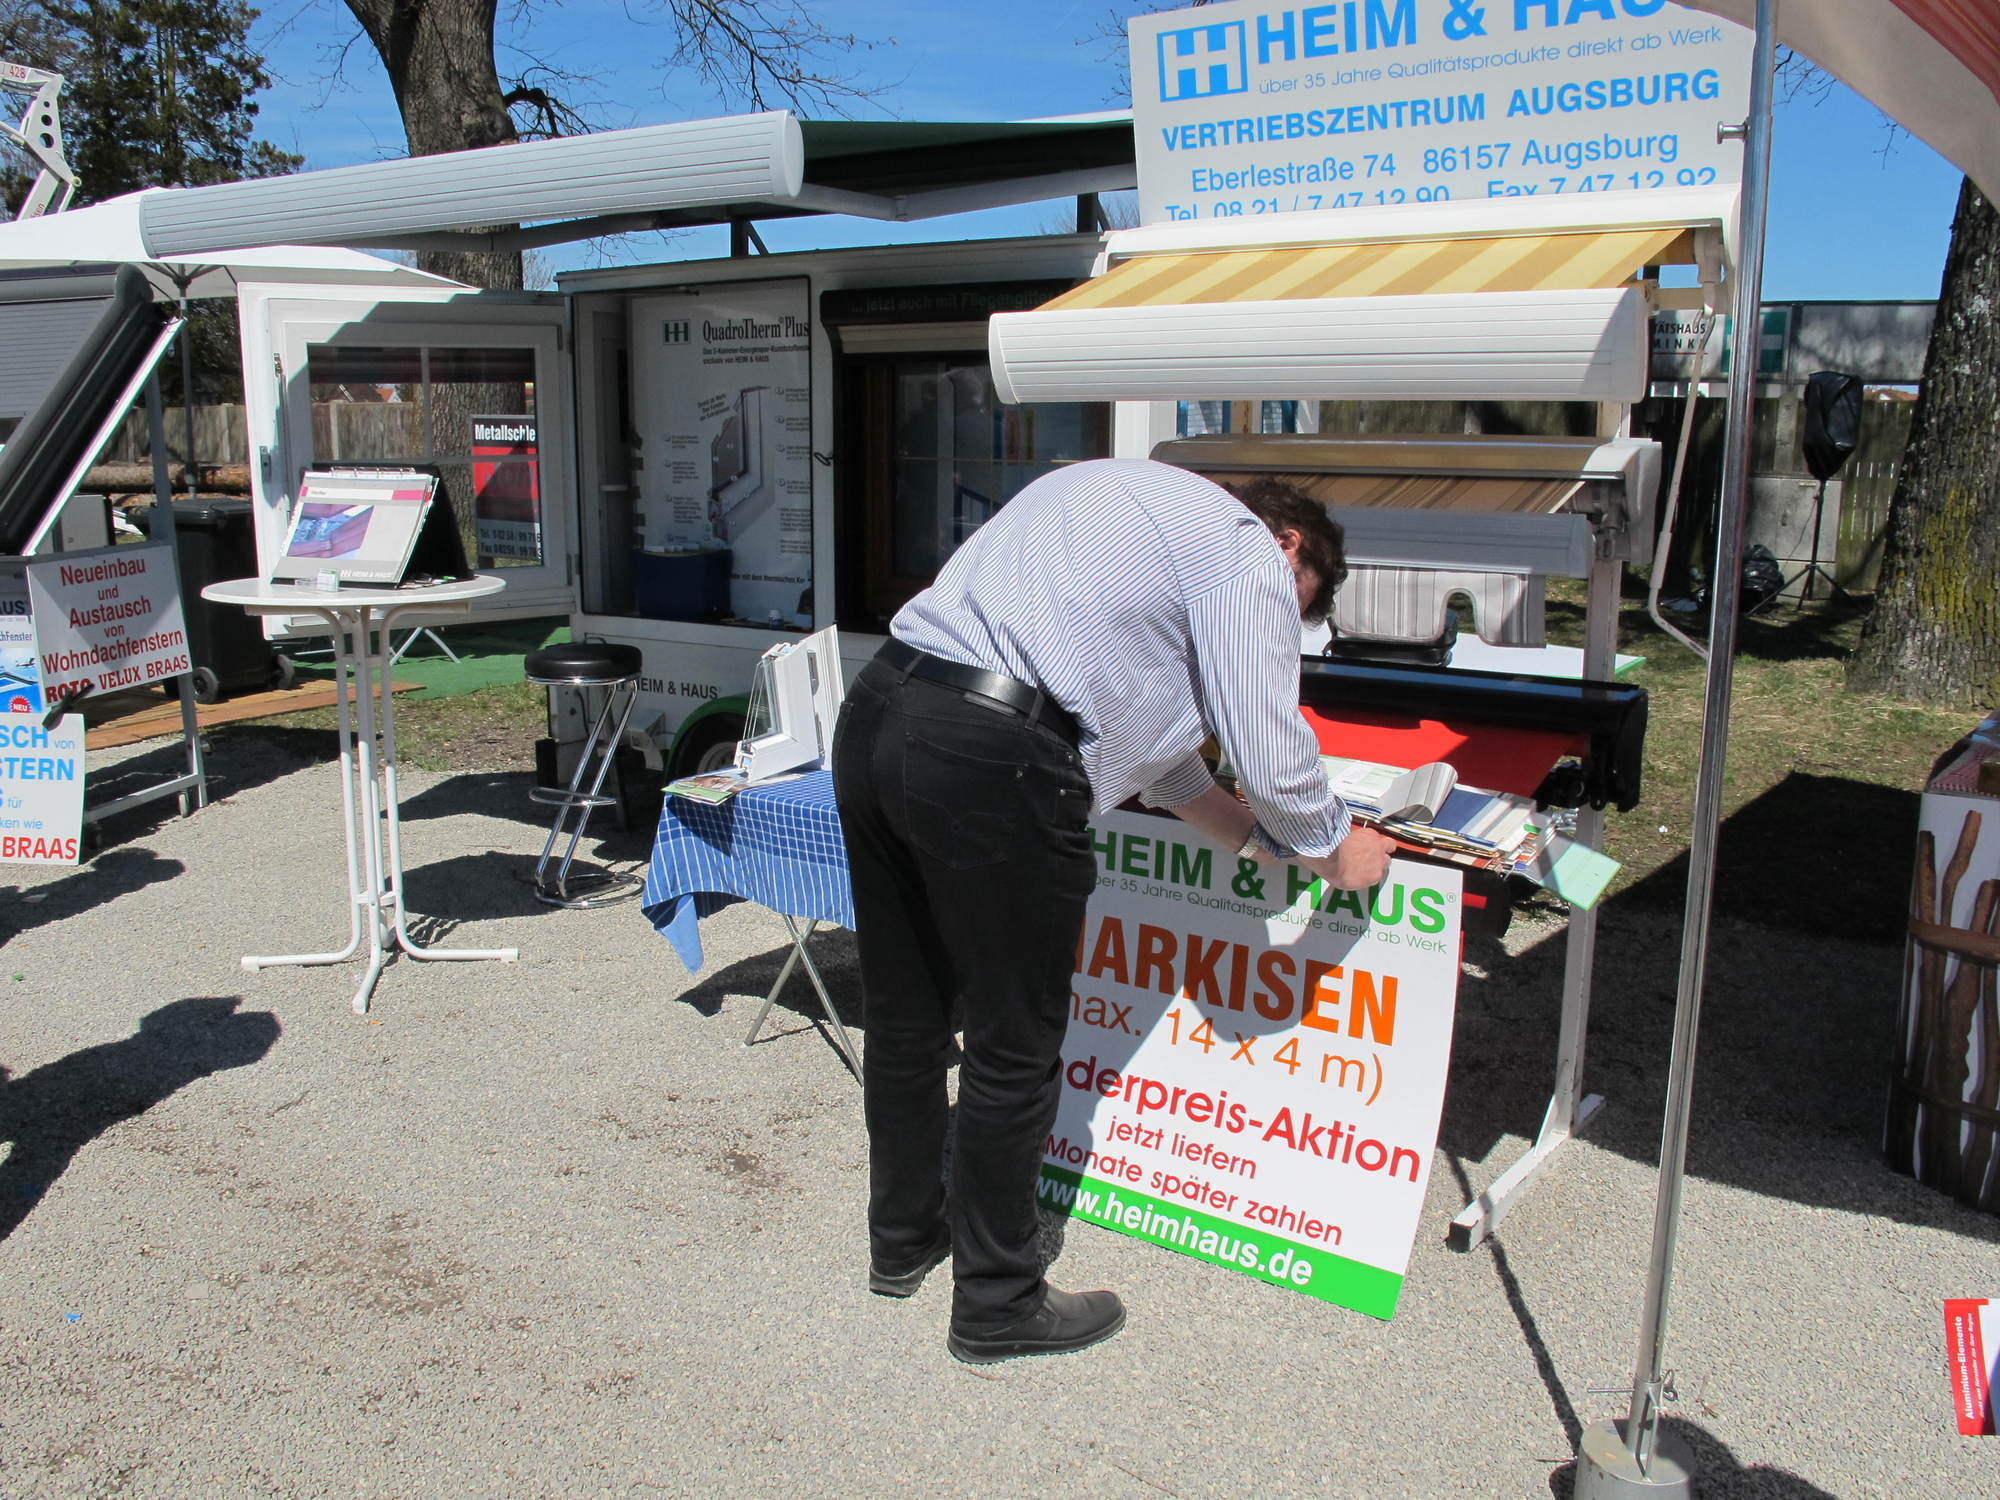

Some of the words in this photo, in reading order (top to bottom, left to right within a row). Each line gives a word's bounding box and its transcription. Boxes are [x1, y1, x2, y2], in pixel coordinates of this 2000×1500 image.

[1257, 0, 1416, 64] HEIM
[1442, 0, 1488, 40] &
[9, 65, 27, 79] 428
[1259, 77, 1299, 95] über
[1304, 74, 1326, 89] 35
[1332, 68, 1382, 86] Jahre
[1387, 45, 1561, 79] Qualitätsprodukte
[1567, 36, 1624, 58] direkt
[1630, 32, 1662, 51] ab
[1668, 26, 1722, 46] Werk
[1161, 92, 1485, 151] VERTRIEBSZENTRUM
[1506, 68, 1720, 118] AUGSBURG
[1191, 156, 1354, 193] Eberlestraße
[1363, 153, 1396, 178] 74
[1423, 143, 1511, 174] 86157
[1521, 133, 1679, 170] Augsburg
[785, 316, 809, 338] Plus
[60, 558, 146, 587] Neueinbau
[98, 584, 119, 600] und
[70, 595, 152, 628] Austausch
[104, 624, 125, 638] von
[42, 630, 184, 675] Wohndachfenstern
[98, 665, 141, 691] VELUX
[146, 654, 189, 679] BRAAS
[668, 681, 676, 695] &
[13, 702, 28, 712] NEU
[54, 739, 76, 750] von
[8, 797, 22, 809] für
[24, 818, 43, 830] wie
[2, 836, 77, 860] BRAAS
[1087, 827, 1212, 890] HEIM
[1231, 857, 1266, 901] &
[1120, 878, 1138, 893] 35
[1141, 881, 1183, 902] Jahre
[1328, 920, 1372, 940] direkt
[1377, 930, 1401, 945] ab
[1406, 934, 1447, 955] Werk
[1166, 1007, 1215, 1055] 14
[1230, 1031, 1258, 1066] x
[1272, 1037, 1301, 1076] 4
[1320, 1052, 1384, 1107] m)
[1059, 1054, 1420, 1183] derpreis-Aktion
[1106, 1115, 1164, 1151] jetzt
[1171, 1132, 1257, 1179] liefern
[1044, 1133, 1143, 1183] Monate
[1150, 1171, 1238, 1213] später
[1244, 1200, 1342, 1247] zahlen
[1954, 1316, 1976, 1420] Aluminium-Elemente
